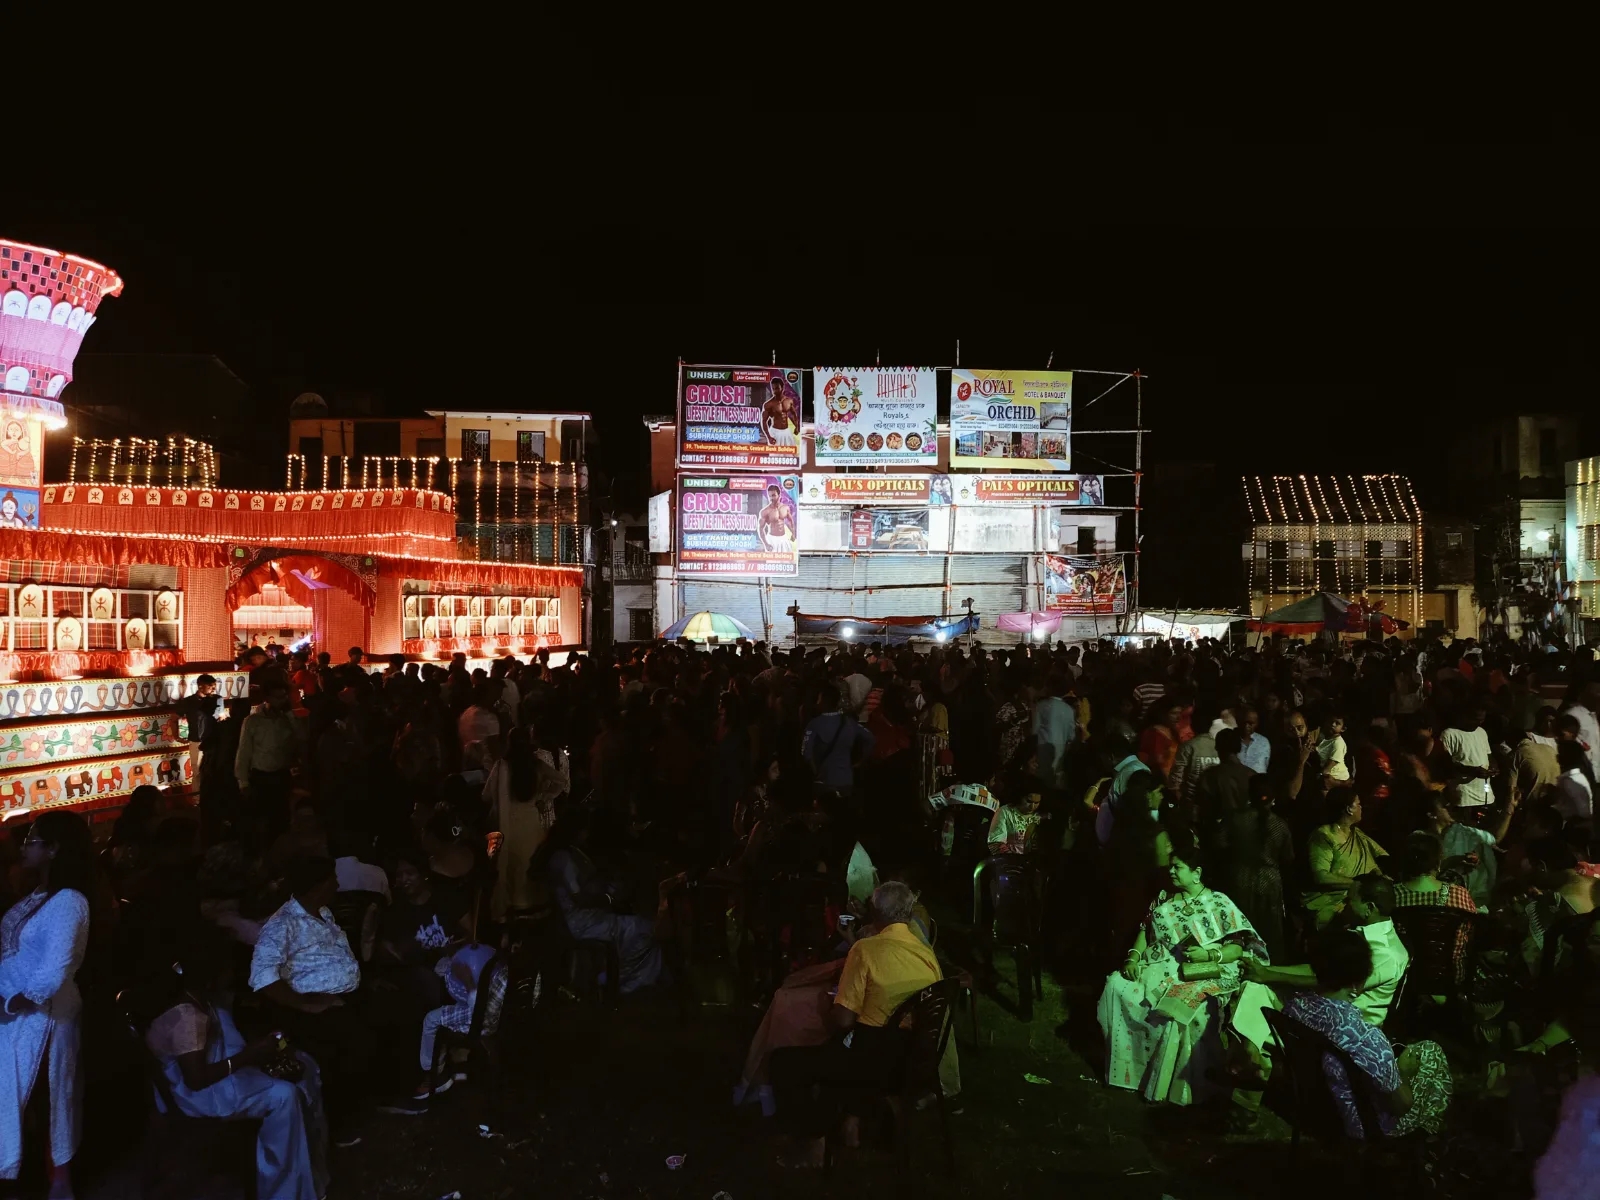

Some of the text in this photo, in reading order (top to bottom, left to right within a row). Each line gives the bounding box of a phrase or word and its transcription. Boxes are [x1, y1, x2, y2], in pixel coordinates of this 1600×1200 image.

[690, 371, 726, 380] UNISEX
[877, 373, 916, 398] ROYAL'S
[974, 378, 1014, 396] ROYAL
[686, 384, 746, 405] CRUSH
[686, 405, 760, 424] LIFESTYLE FITNESS STUDIO
[883, 412, 904, 420] Royals
[988, 405, 1036, 420] ORCHID
[686, 478, 722, 487] UNISEX
[832, 480, 925, 491] PAL'S OPTICALS
[982, 480, 1074, 492] PAL'S OPTICALS
[683, 492, 742, 512] CRUSH
[683, 514, 757, 532] LIFESTYLE FITNESS STUDIO
